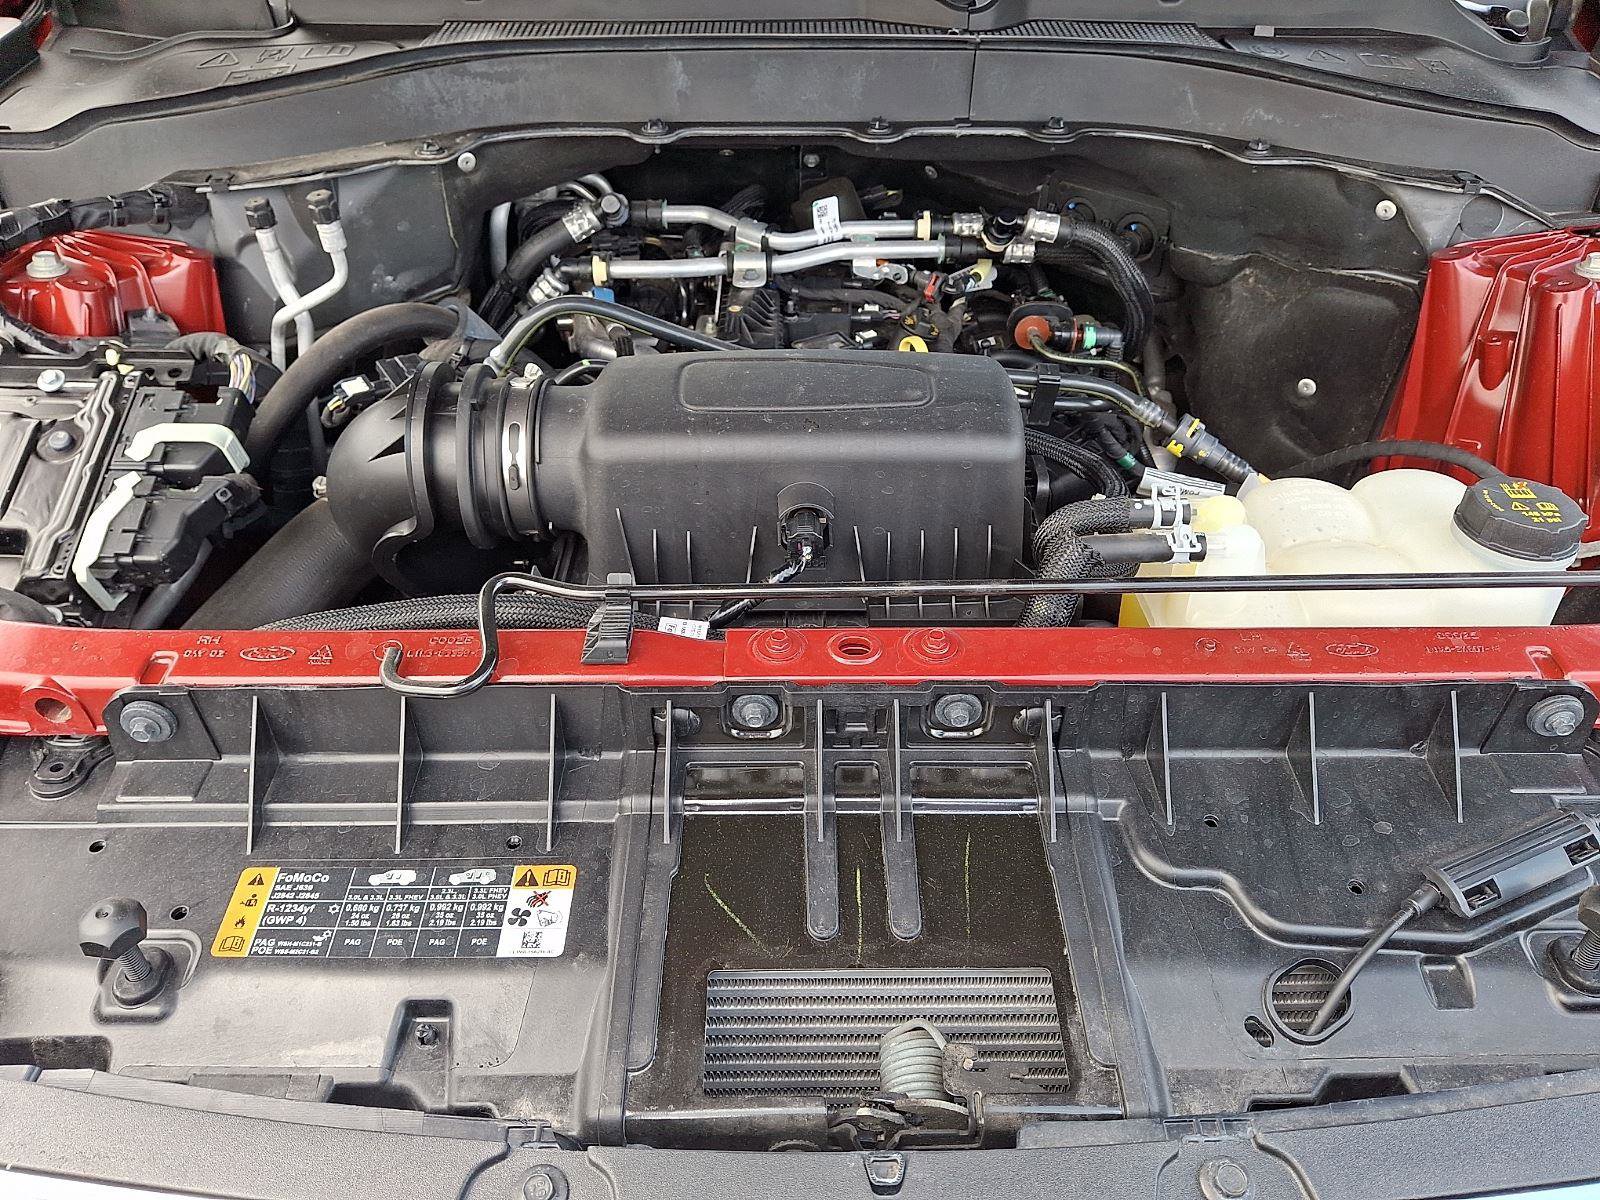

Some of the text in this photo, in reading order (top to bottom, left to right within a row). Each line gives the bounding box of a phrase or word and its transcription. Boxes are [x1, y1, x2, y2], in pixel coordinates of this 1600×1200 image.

[276, 872, 330, 882] FoMoCo
[267, 904, 316, 914] R-1234yf
[369, 904, 380, 913] kg
[409, 904, 420, 913] kg
[453, 903, 464, 912] kg
[494, 903, 504, 912] kg
[262, 915, 307, 926] (GWP 4)
